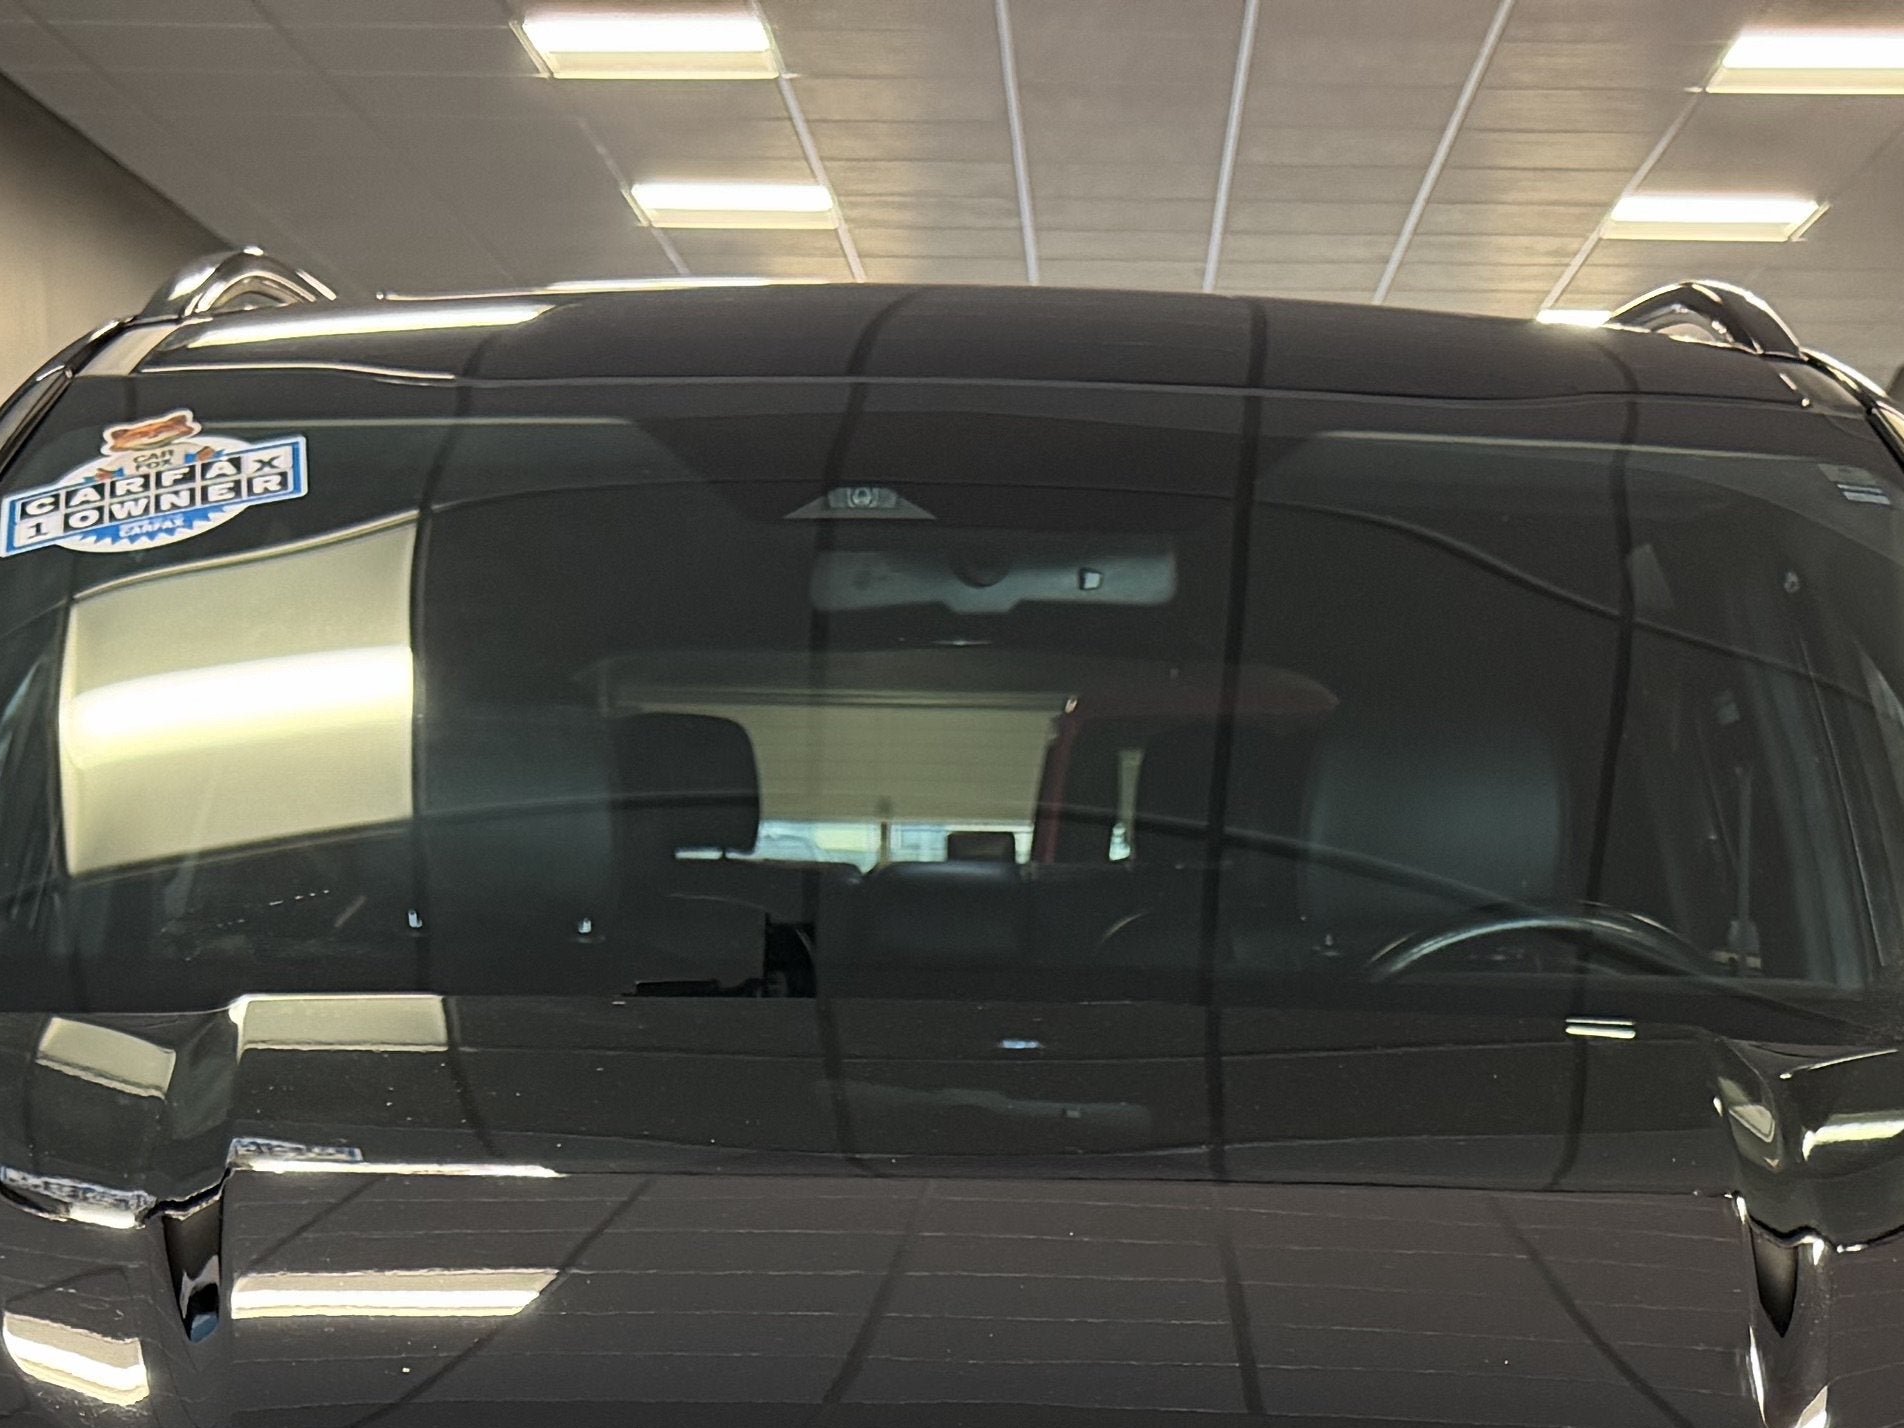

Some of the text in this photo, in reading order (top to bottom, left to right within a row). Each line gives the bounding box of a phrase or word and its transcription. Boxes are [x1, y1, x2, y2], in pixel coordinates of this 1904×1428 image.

[133, 449, 175, 465] CAR
[135, 458, 173, 472] FOX
[25, 455, 283, 516] CARFAX
[28, 474, 283, 540] 1 OWNER
[121, 517, 186, 537] CARFAX
